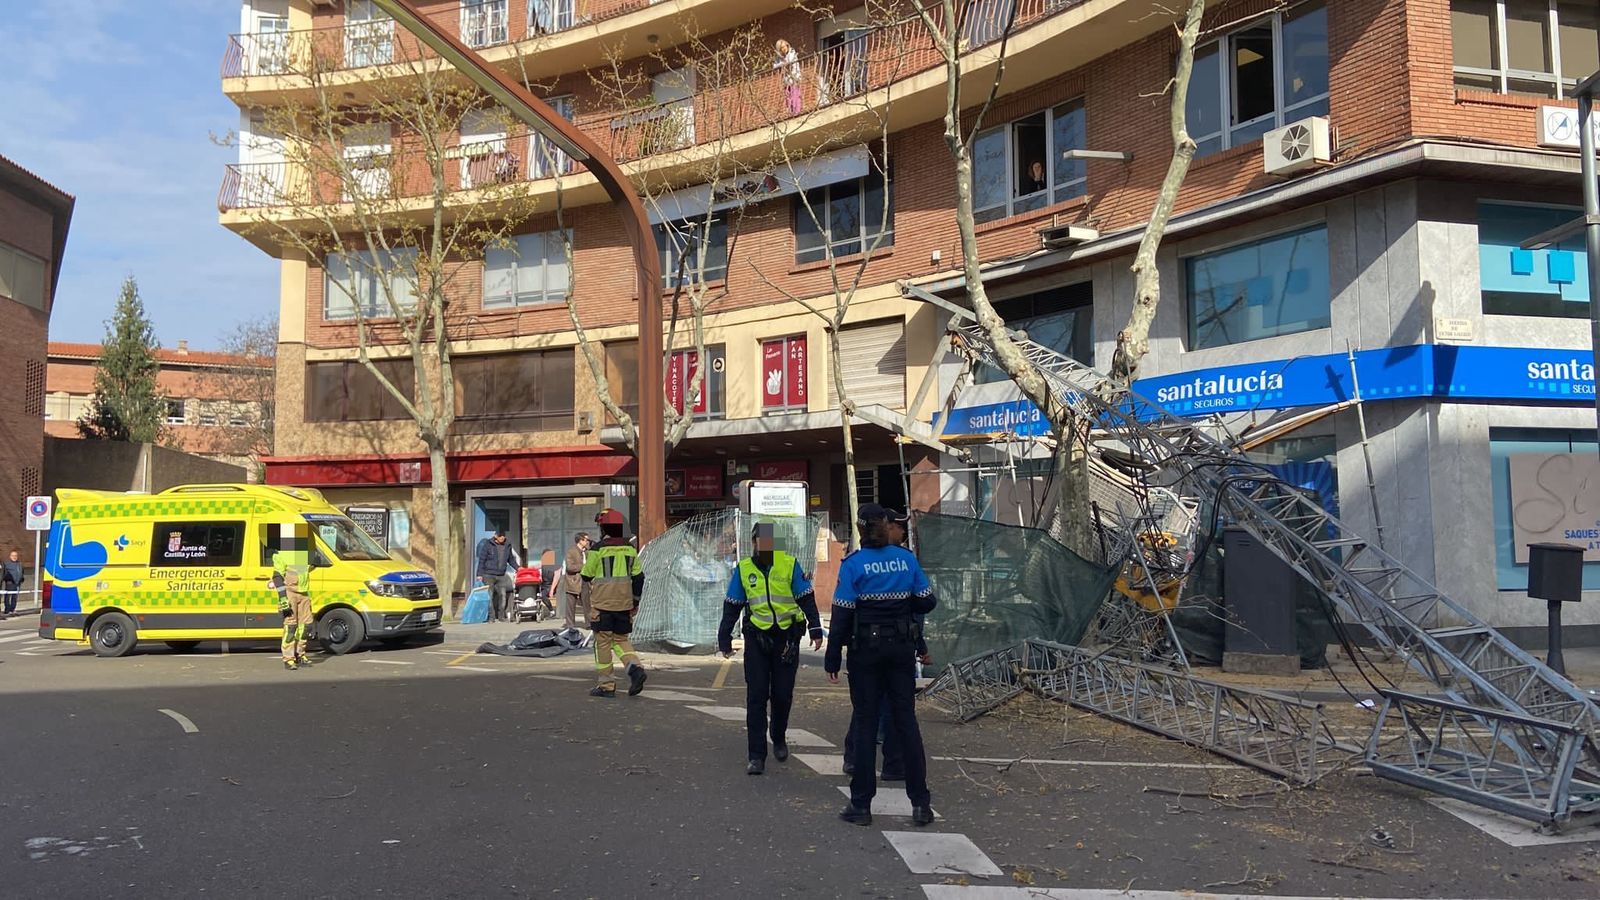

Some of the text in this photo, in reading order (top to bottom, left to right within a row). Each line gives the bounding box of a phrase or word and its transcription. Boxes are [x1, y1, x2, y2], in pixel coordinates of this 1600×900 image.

[1157, 369, 1283, 403] santalucía
[1194, 397, 1234, 409] SEGUROS
[969, 408, 1040, 429] santaluca
[864, 557, 908, 575] POLICÍA
[149, 568, 225, 580] Emergencias
[166, 580, 224, 591] Sanitarias
